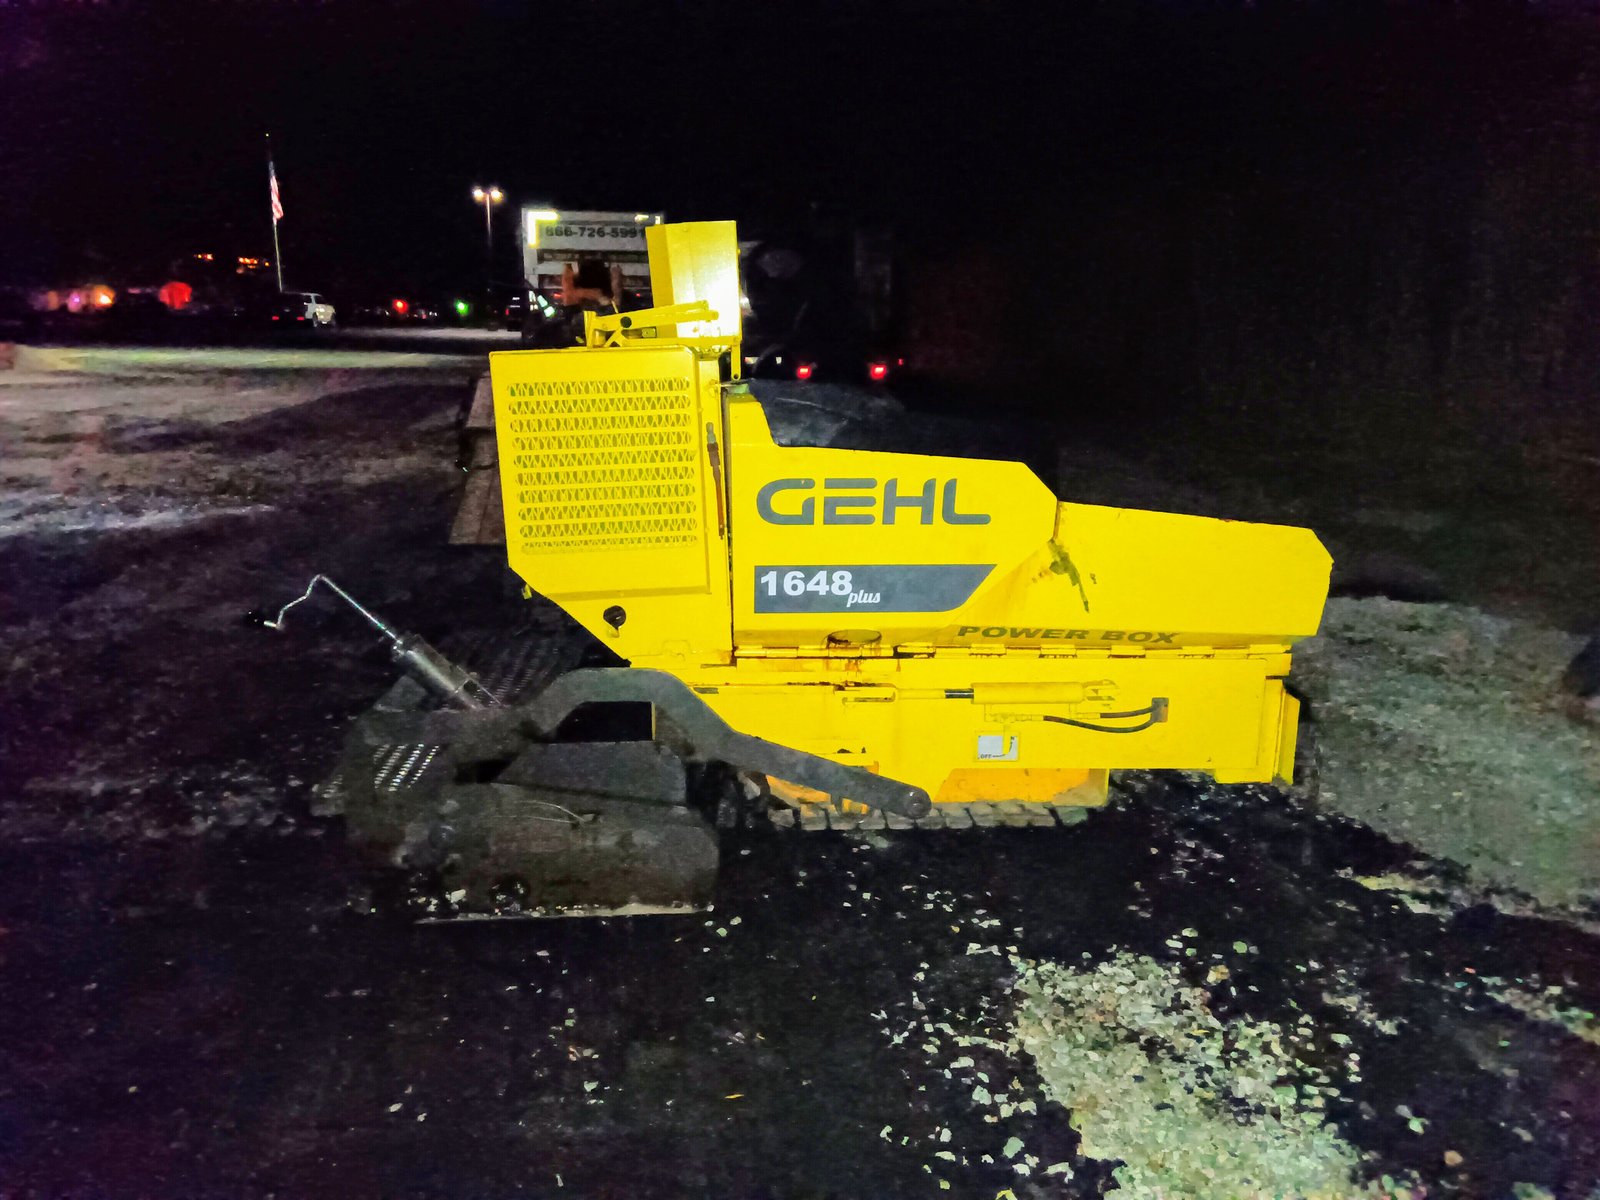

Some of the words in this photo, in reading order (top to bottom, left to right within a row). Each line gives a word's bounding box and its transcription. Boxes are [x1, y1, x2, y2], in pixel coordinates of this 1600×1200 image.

[756, 477, 992, 526] GEHL
[760, 570, 853, 596] 1648
[846, 589, 881, 608] plus
[957, 625, 1090, 641] POWER
[1100, 630, 1178, 644] BOX
